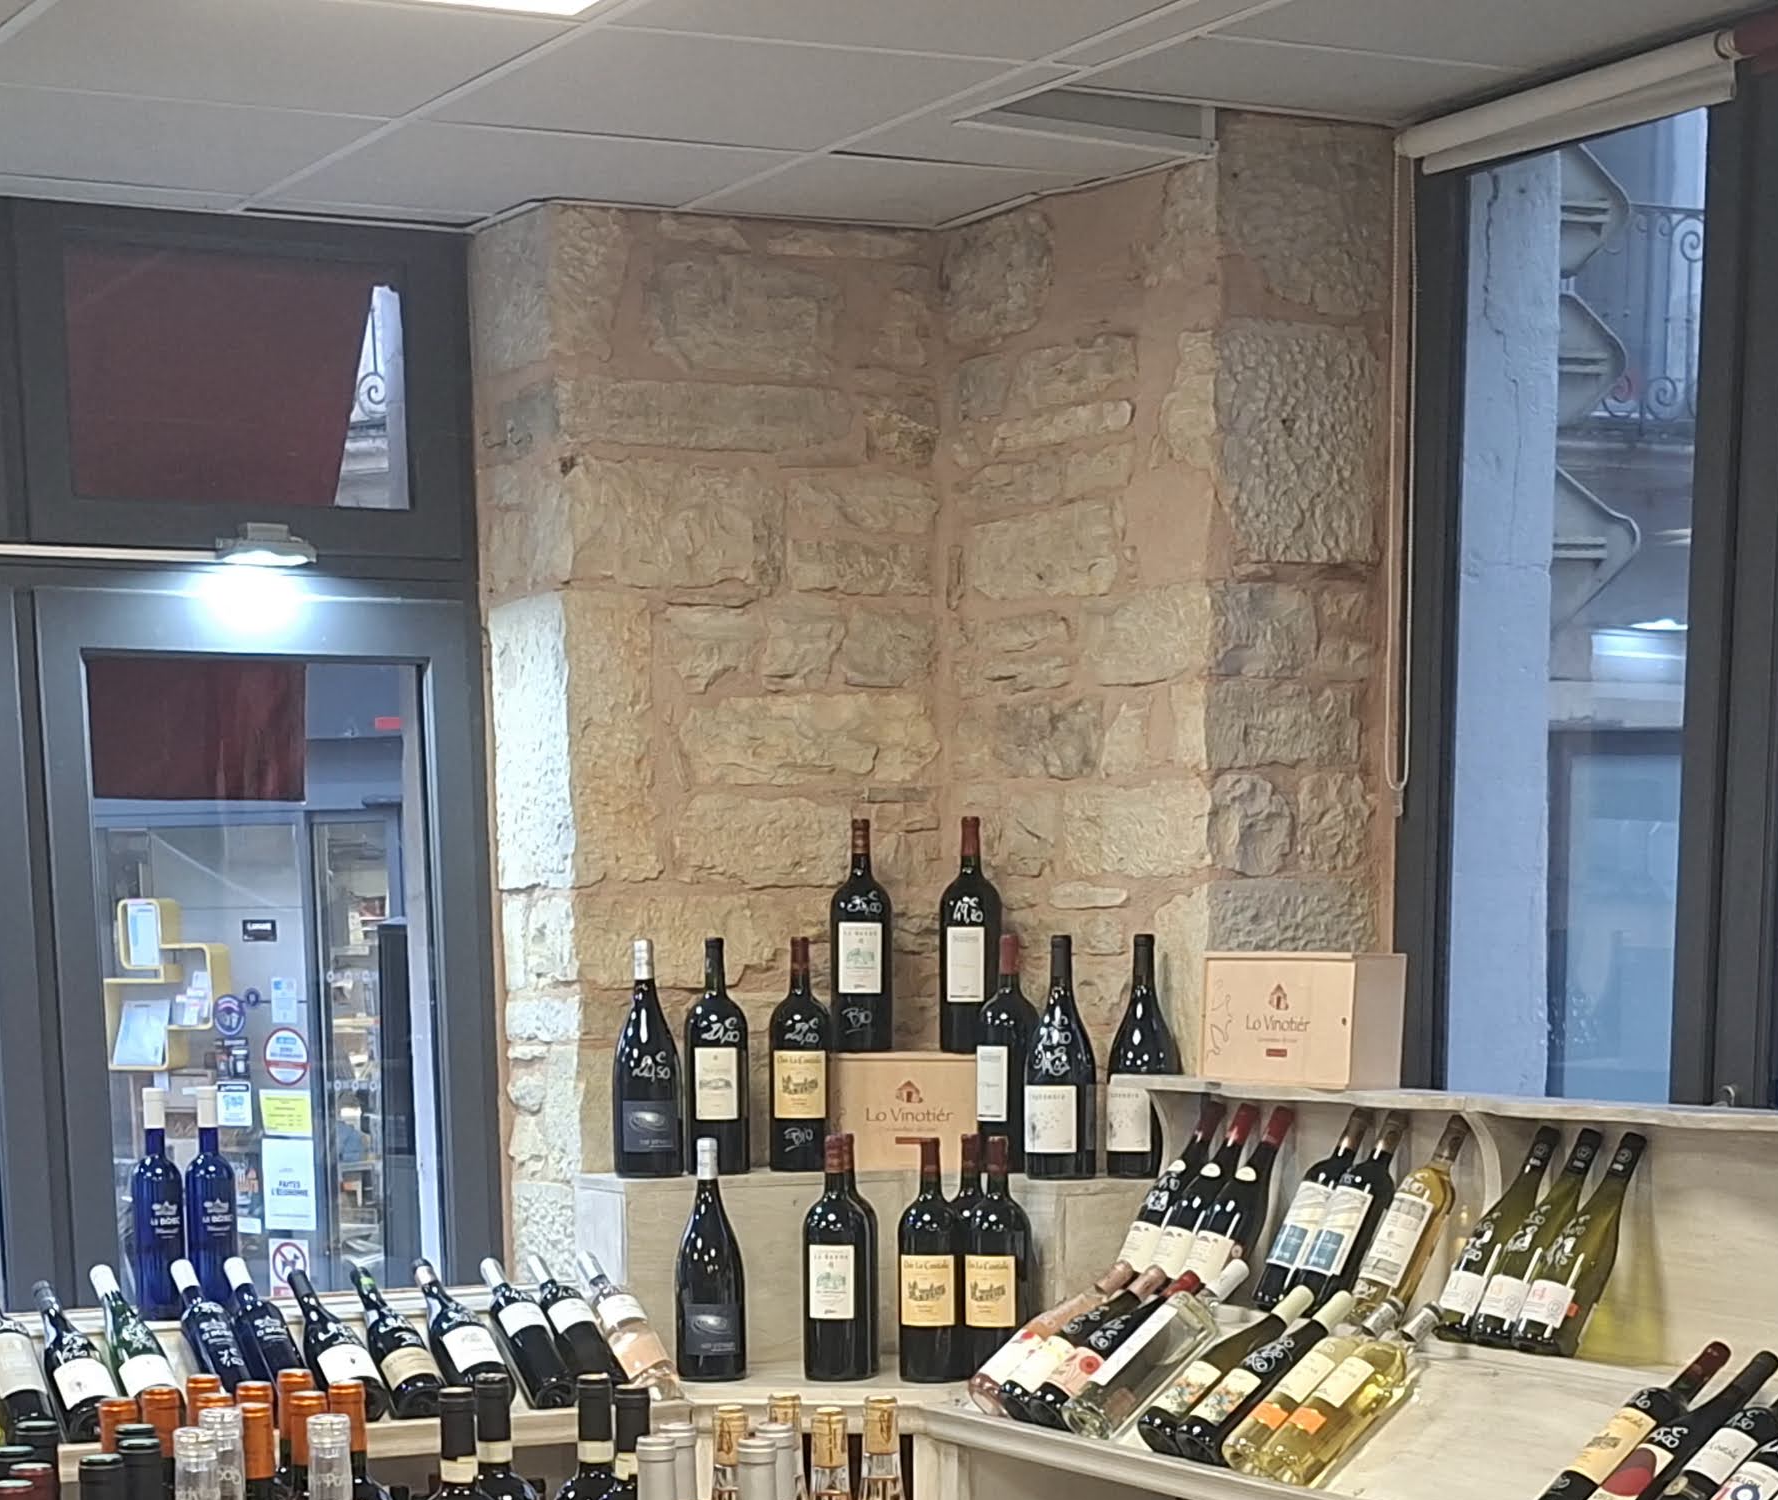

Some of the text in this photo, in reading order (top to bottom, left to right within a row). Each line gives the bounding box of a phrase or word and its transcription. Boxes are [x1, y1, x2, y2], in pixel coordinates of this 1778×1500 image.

[1245, 1014, 1262, 1031] Lo
[865, 1105, 954, 1123] Lo Vinotiér
